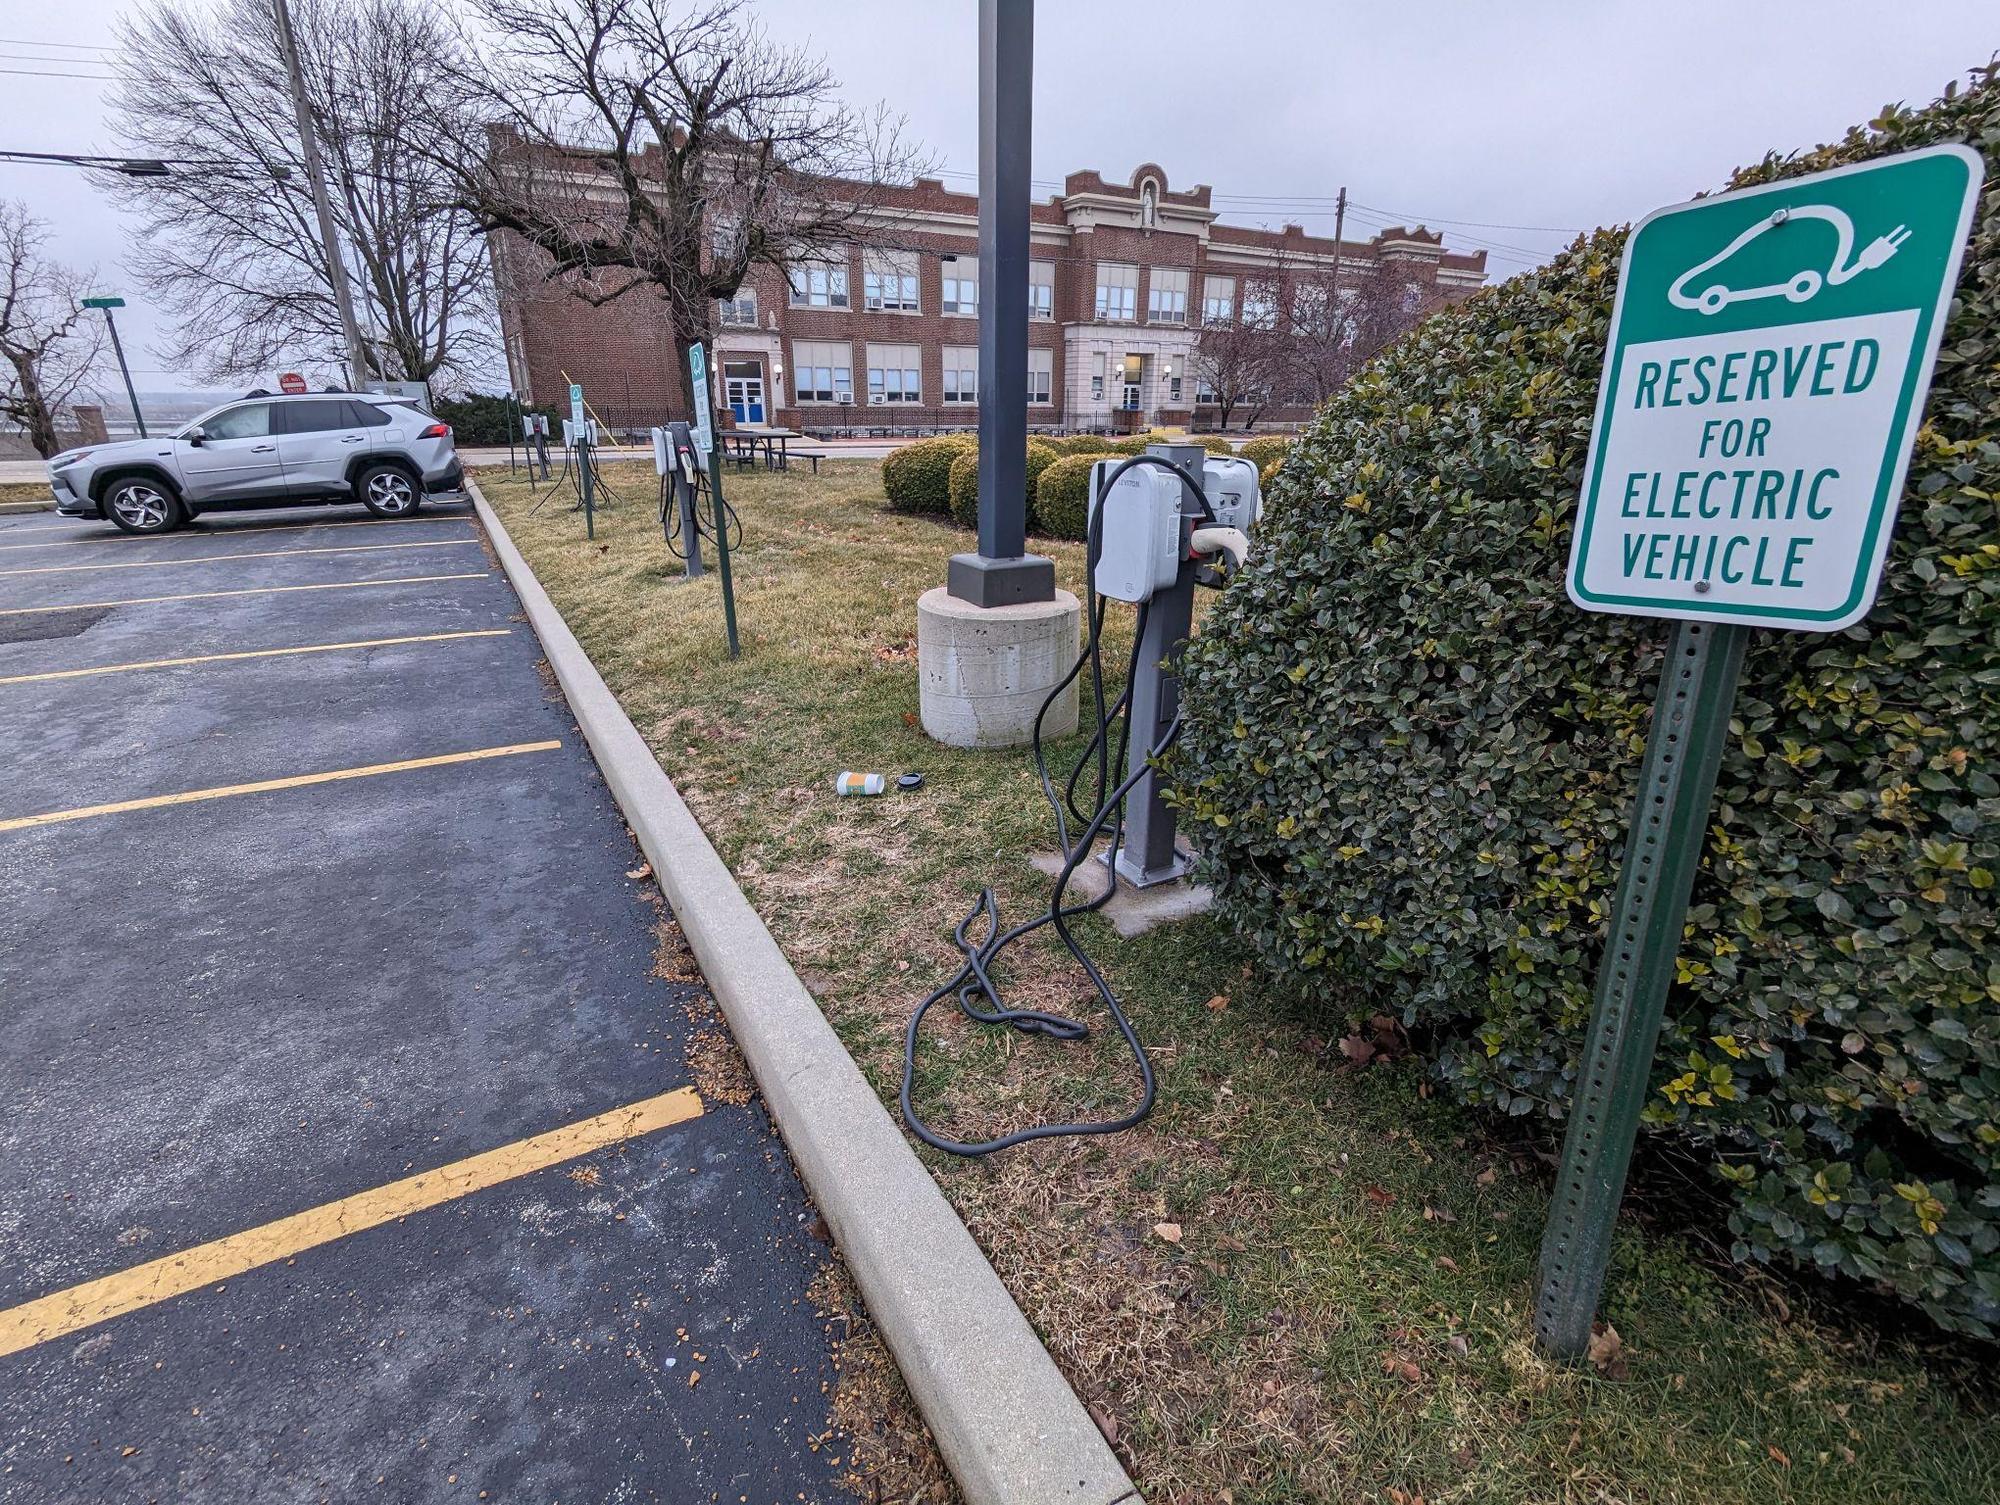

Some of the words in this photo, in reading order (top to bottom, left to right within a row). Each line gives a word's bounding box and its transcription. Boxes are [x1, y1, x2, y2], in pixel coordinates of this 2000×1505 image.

[1634, 338, 1880, 410] RESERVED
[1699, 418, 1772, 459] FOR
[1621, 468, 1840, 520] ELECTRIC
[1622, 533, 1814, 588] VEHICLE
